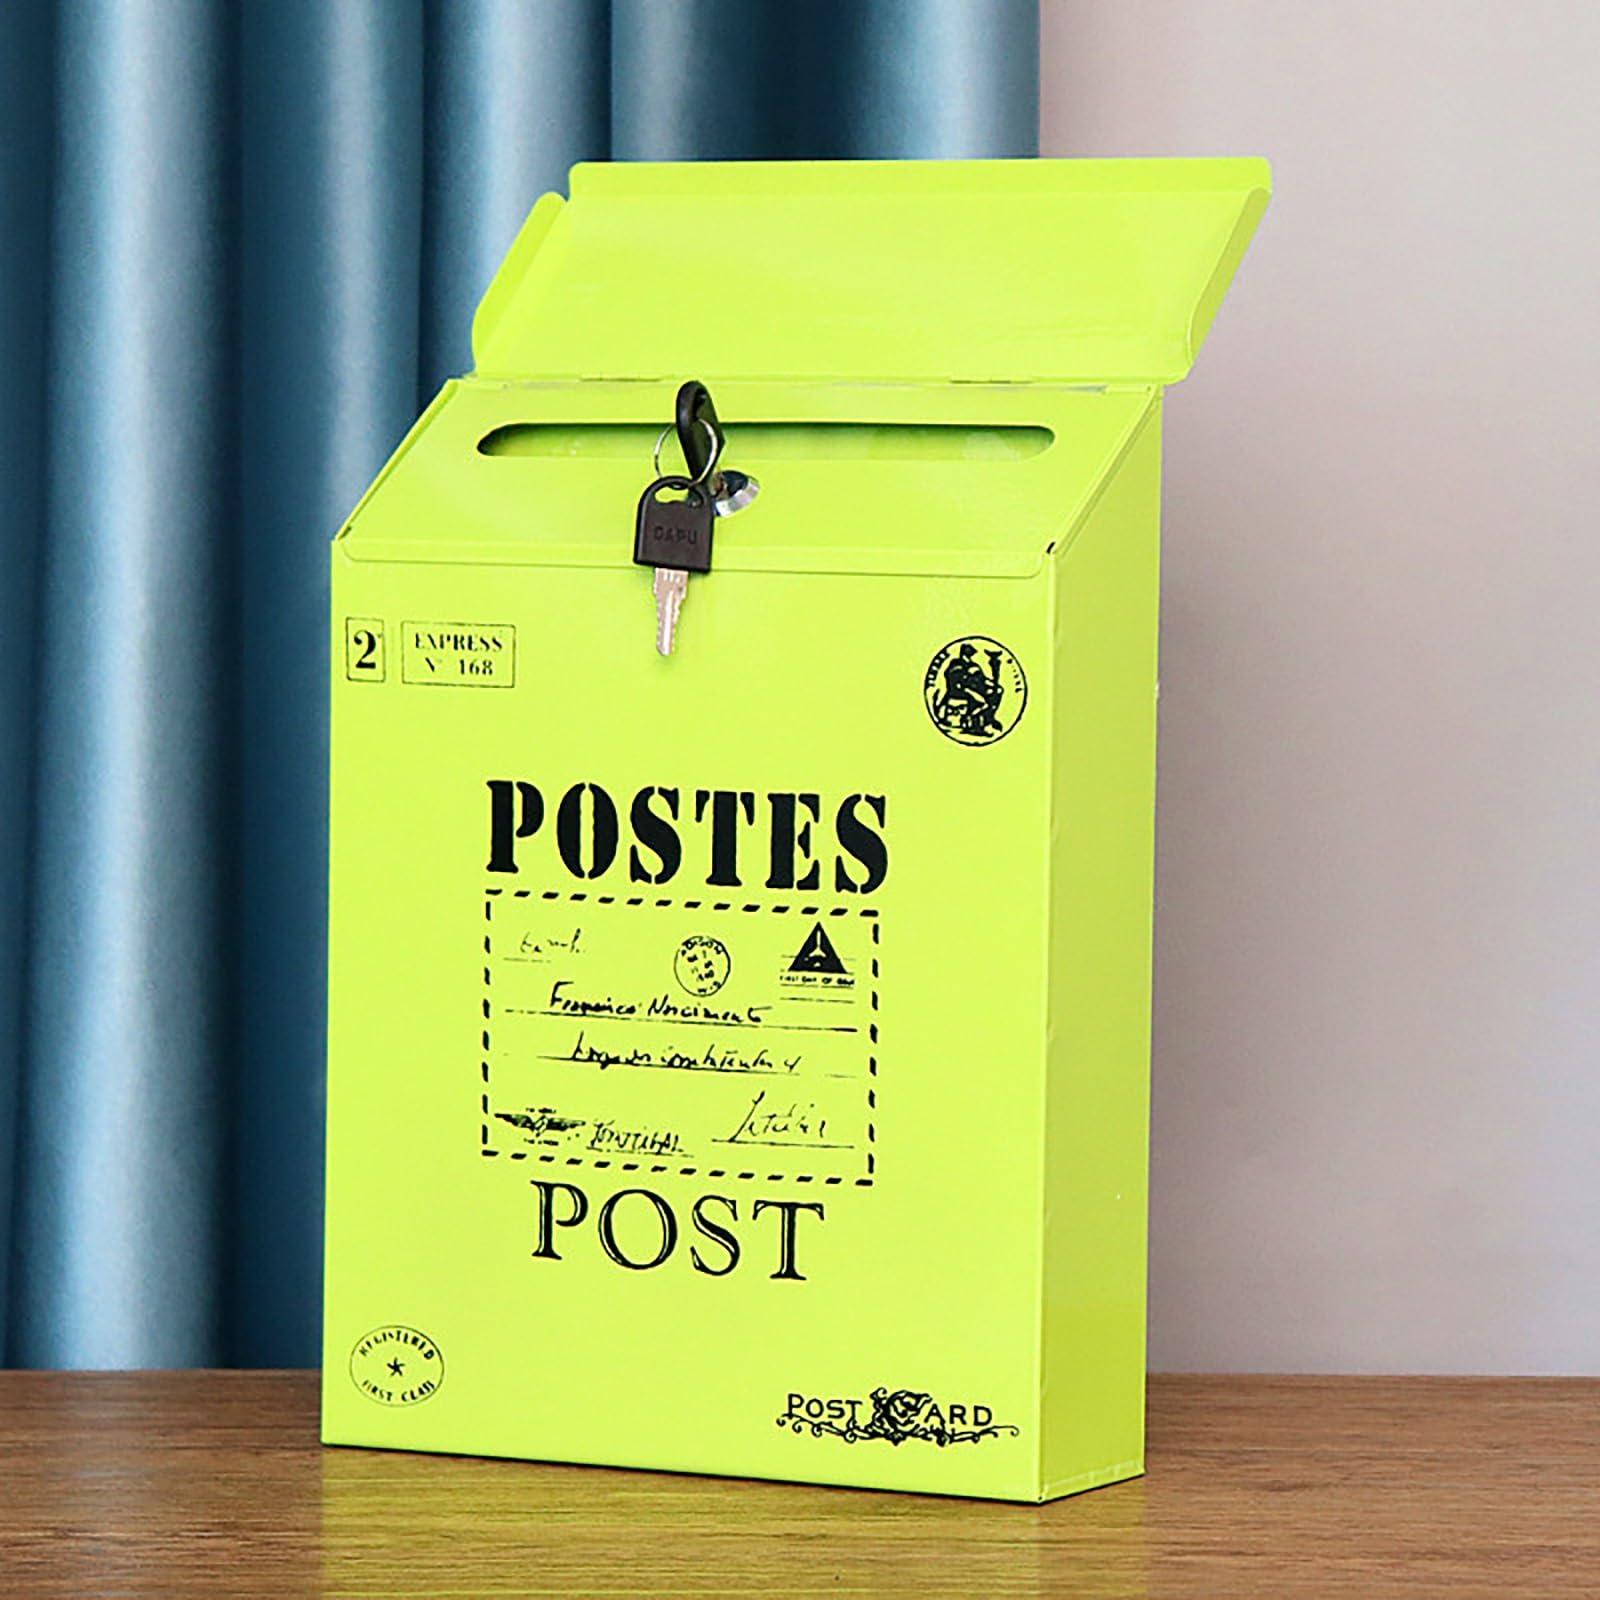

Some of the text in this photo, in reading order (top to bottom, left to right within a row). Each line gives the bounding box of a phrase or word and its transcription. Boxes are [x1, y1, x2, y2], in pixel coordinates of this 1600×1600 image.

[353, 629, 377, 670] 2
[414, 632, 503, 652] EXPRESS
[459, 659, 493, 676] 168
[486, 780, 889, 895] POSTES
[530, 1180, 825, 1281] POST
[787, 1393, 863, 1422] POST
